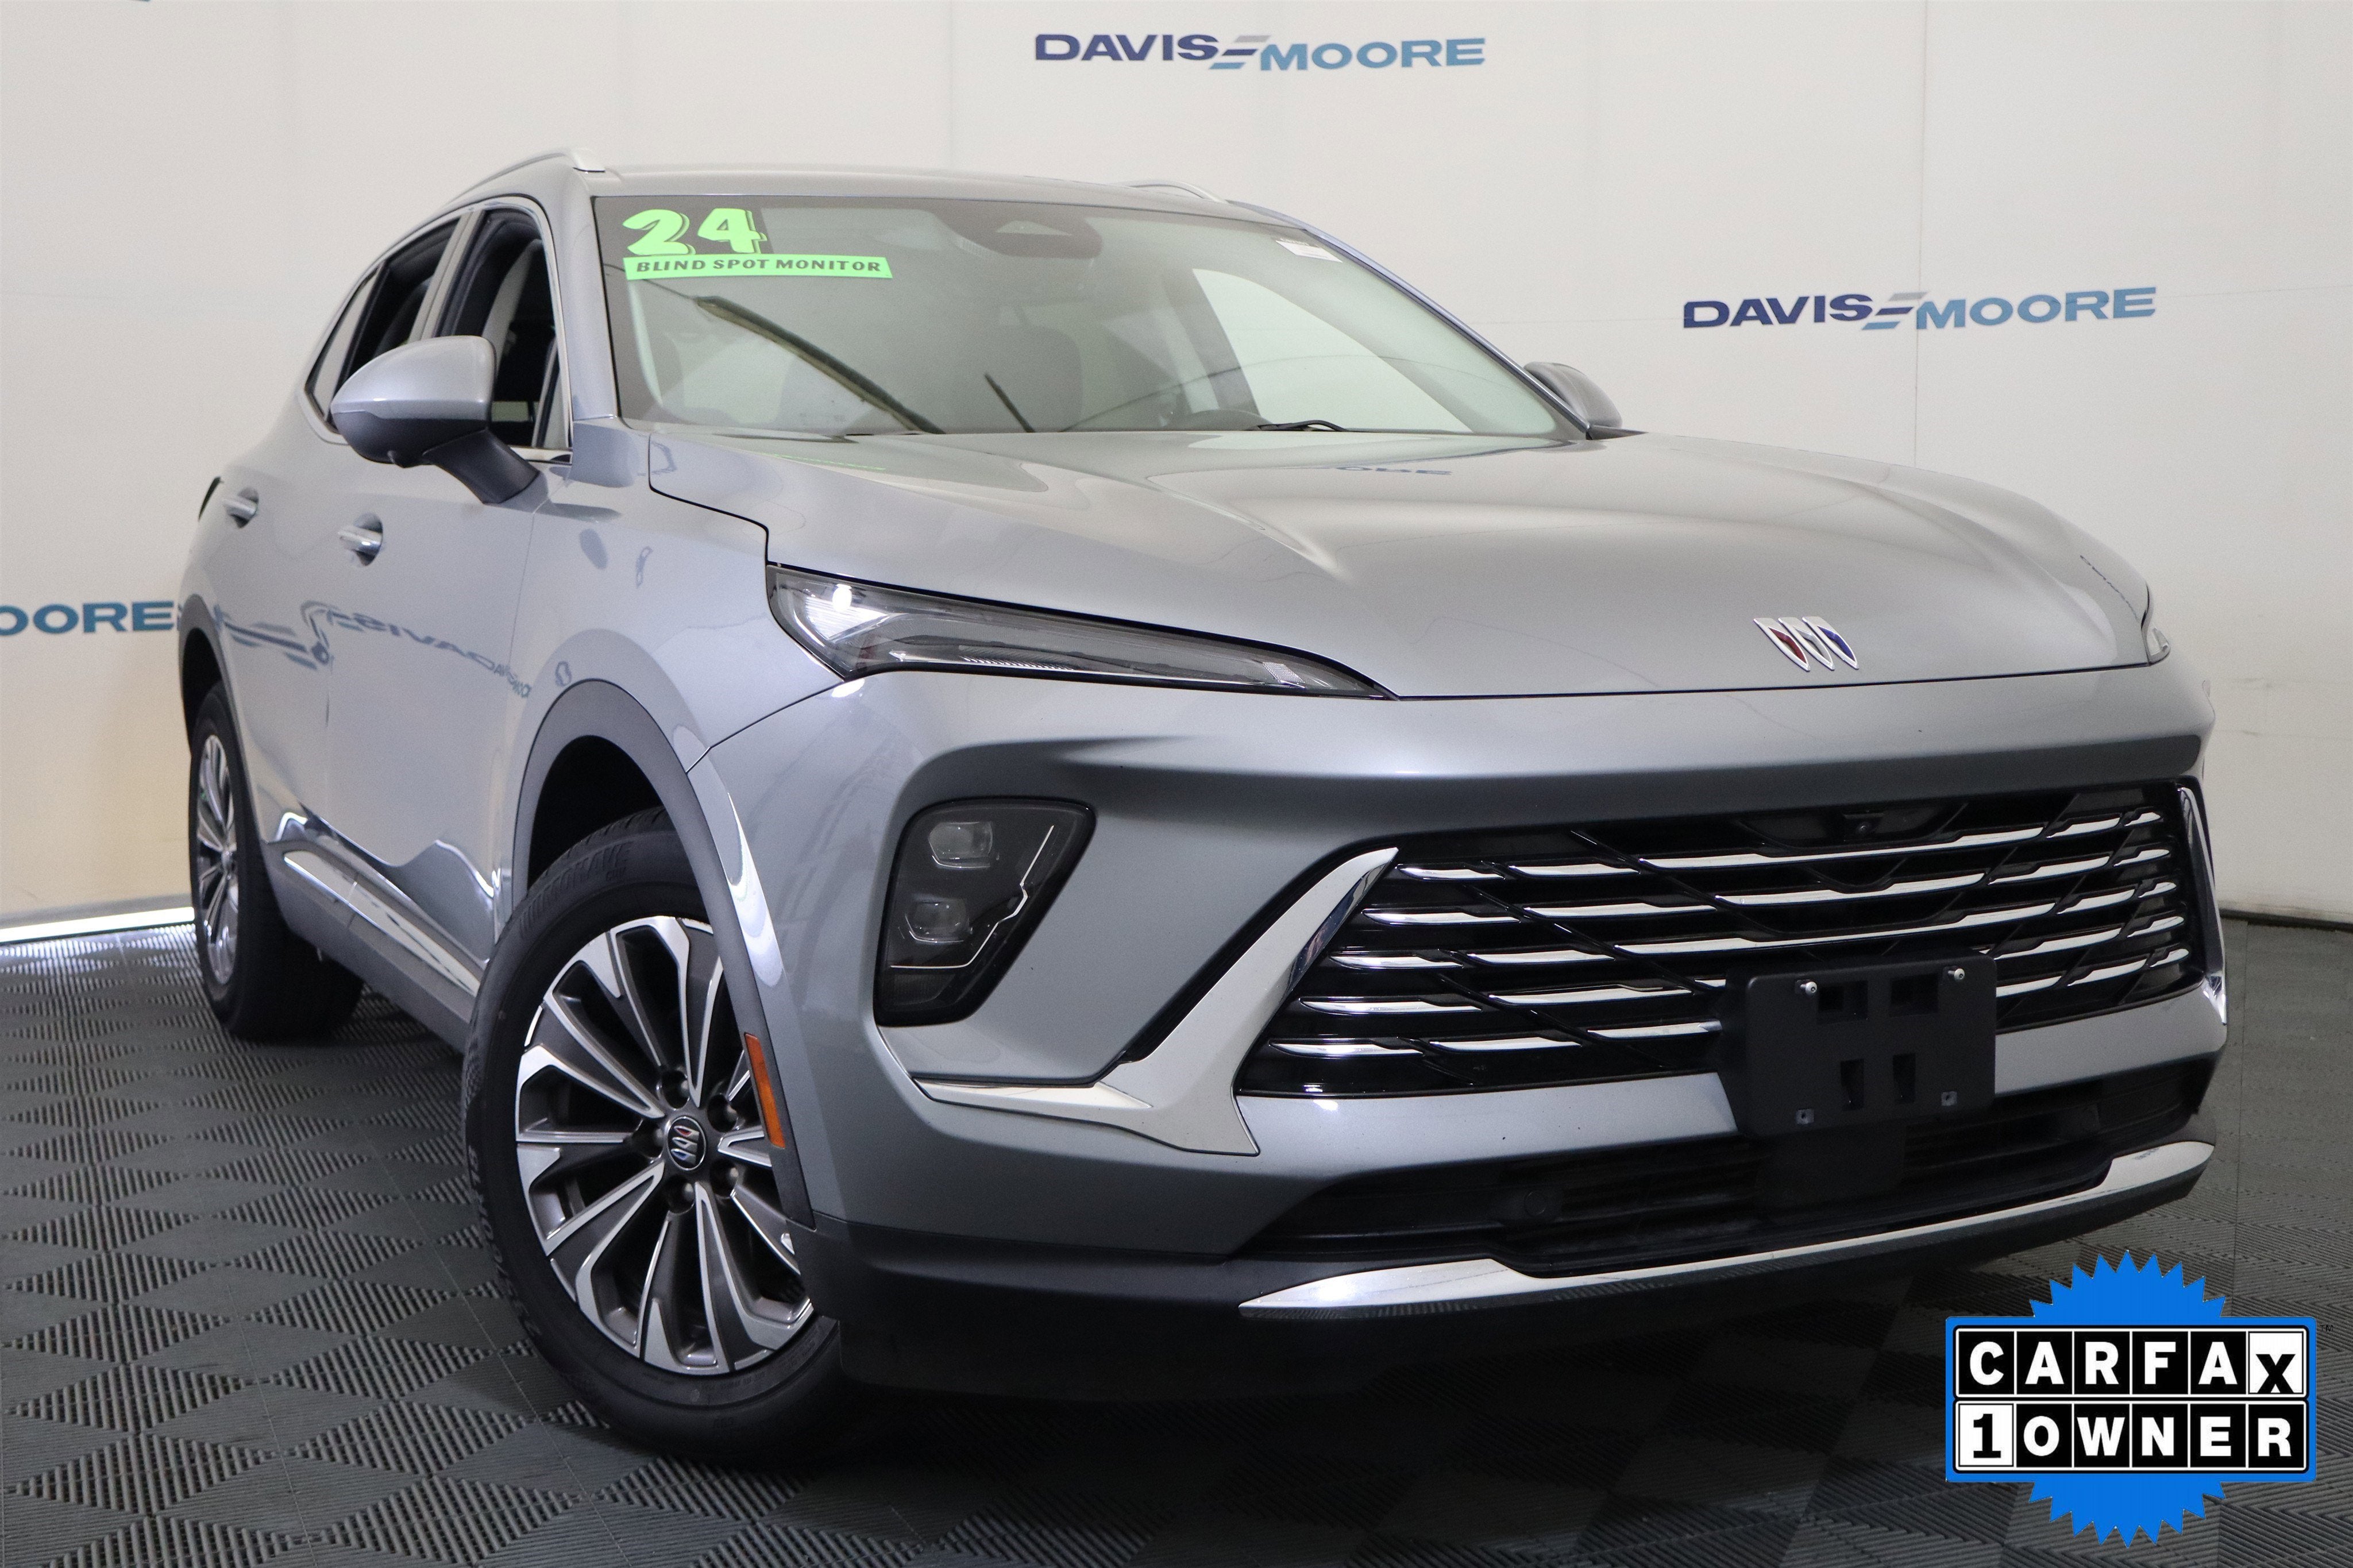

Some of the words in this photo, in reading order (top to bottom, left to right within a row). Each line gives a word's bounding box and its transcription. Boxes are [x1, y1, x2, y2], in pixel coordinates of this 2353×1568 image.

[1036, 34, 1218, 61] DAVIS
[1260, 38, 1486, 71] MOORE
[622, 208, 767, 255] 24
[636, 260, 706, 272] BLIND
[712, 259, 770, 269] SPOT
[776, 259, 881, 272] MONITOR
[1683, 293, 1873, 329] DAVIS
[1916, 287, 2157, 330] MOORE
